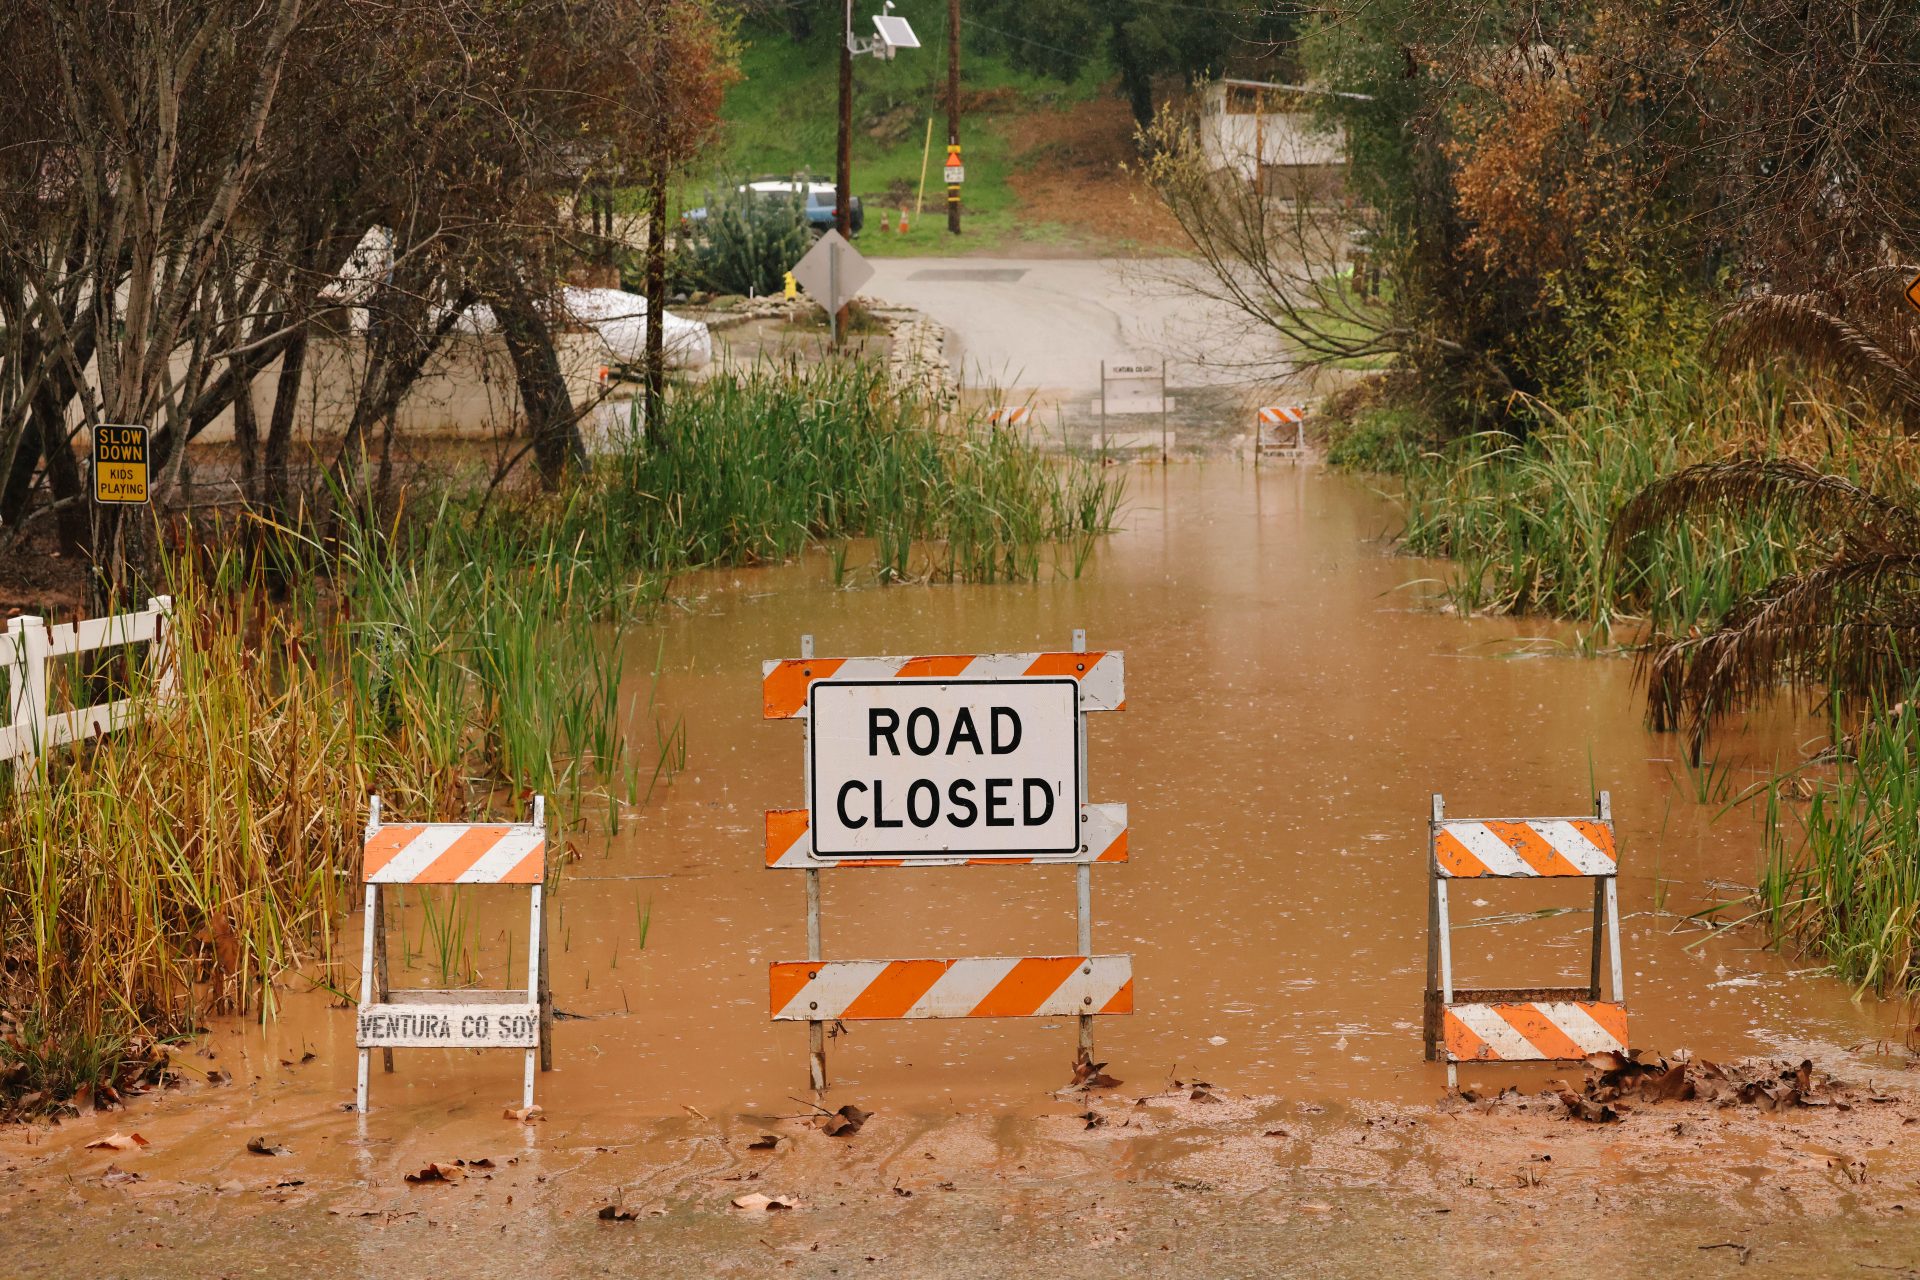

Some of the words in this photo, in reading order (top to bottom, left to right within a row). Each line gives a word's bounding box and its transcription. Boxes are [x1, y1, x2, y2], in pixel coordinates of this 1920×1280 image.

[99, 429, 142, 445] SLOW
[100, 445, 143, 461] DOWN
[110, 469, 133, 480] KIDS
[100, 483, 143, 495] PLAYING
[868, 706, 1022, 756] ROAD
[836, 778, 1055, 830] CLOSED
[360, 1014, 450, 1039] VENTURA
[461, 1015, 489, 1039] CO
[498, 1015, 538, 1039] SOY
